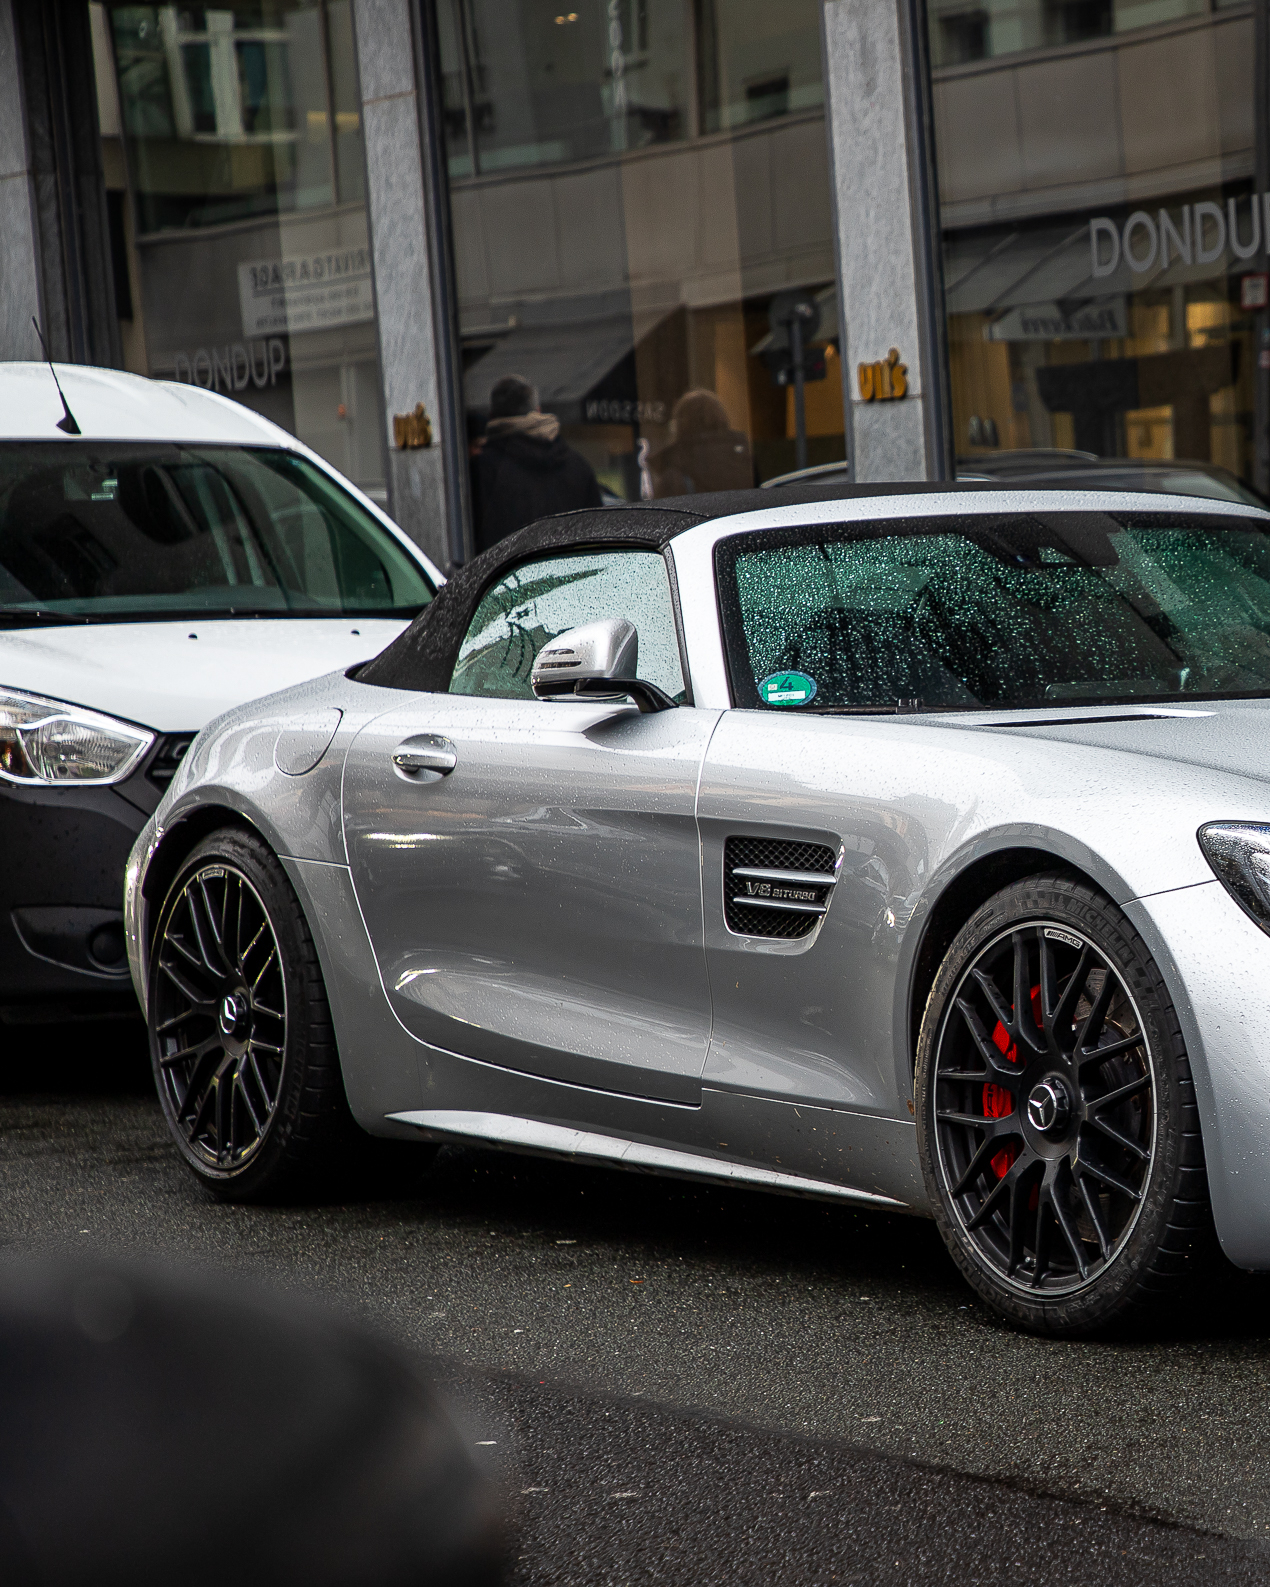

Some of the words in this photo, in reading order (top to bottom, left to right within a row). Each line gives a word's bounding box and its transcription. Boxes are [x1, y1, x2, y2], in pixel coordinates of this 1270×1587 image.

[174, 338, 286, 393] DONDUP
[780, 676, 794, 690] 4
[746, 882, 771, 896] V8
[772, 888, 816, 901] BITURBO
[1066, 898, 1138, 969] MICHELIN
